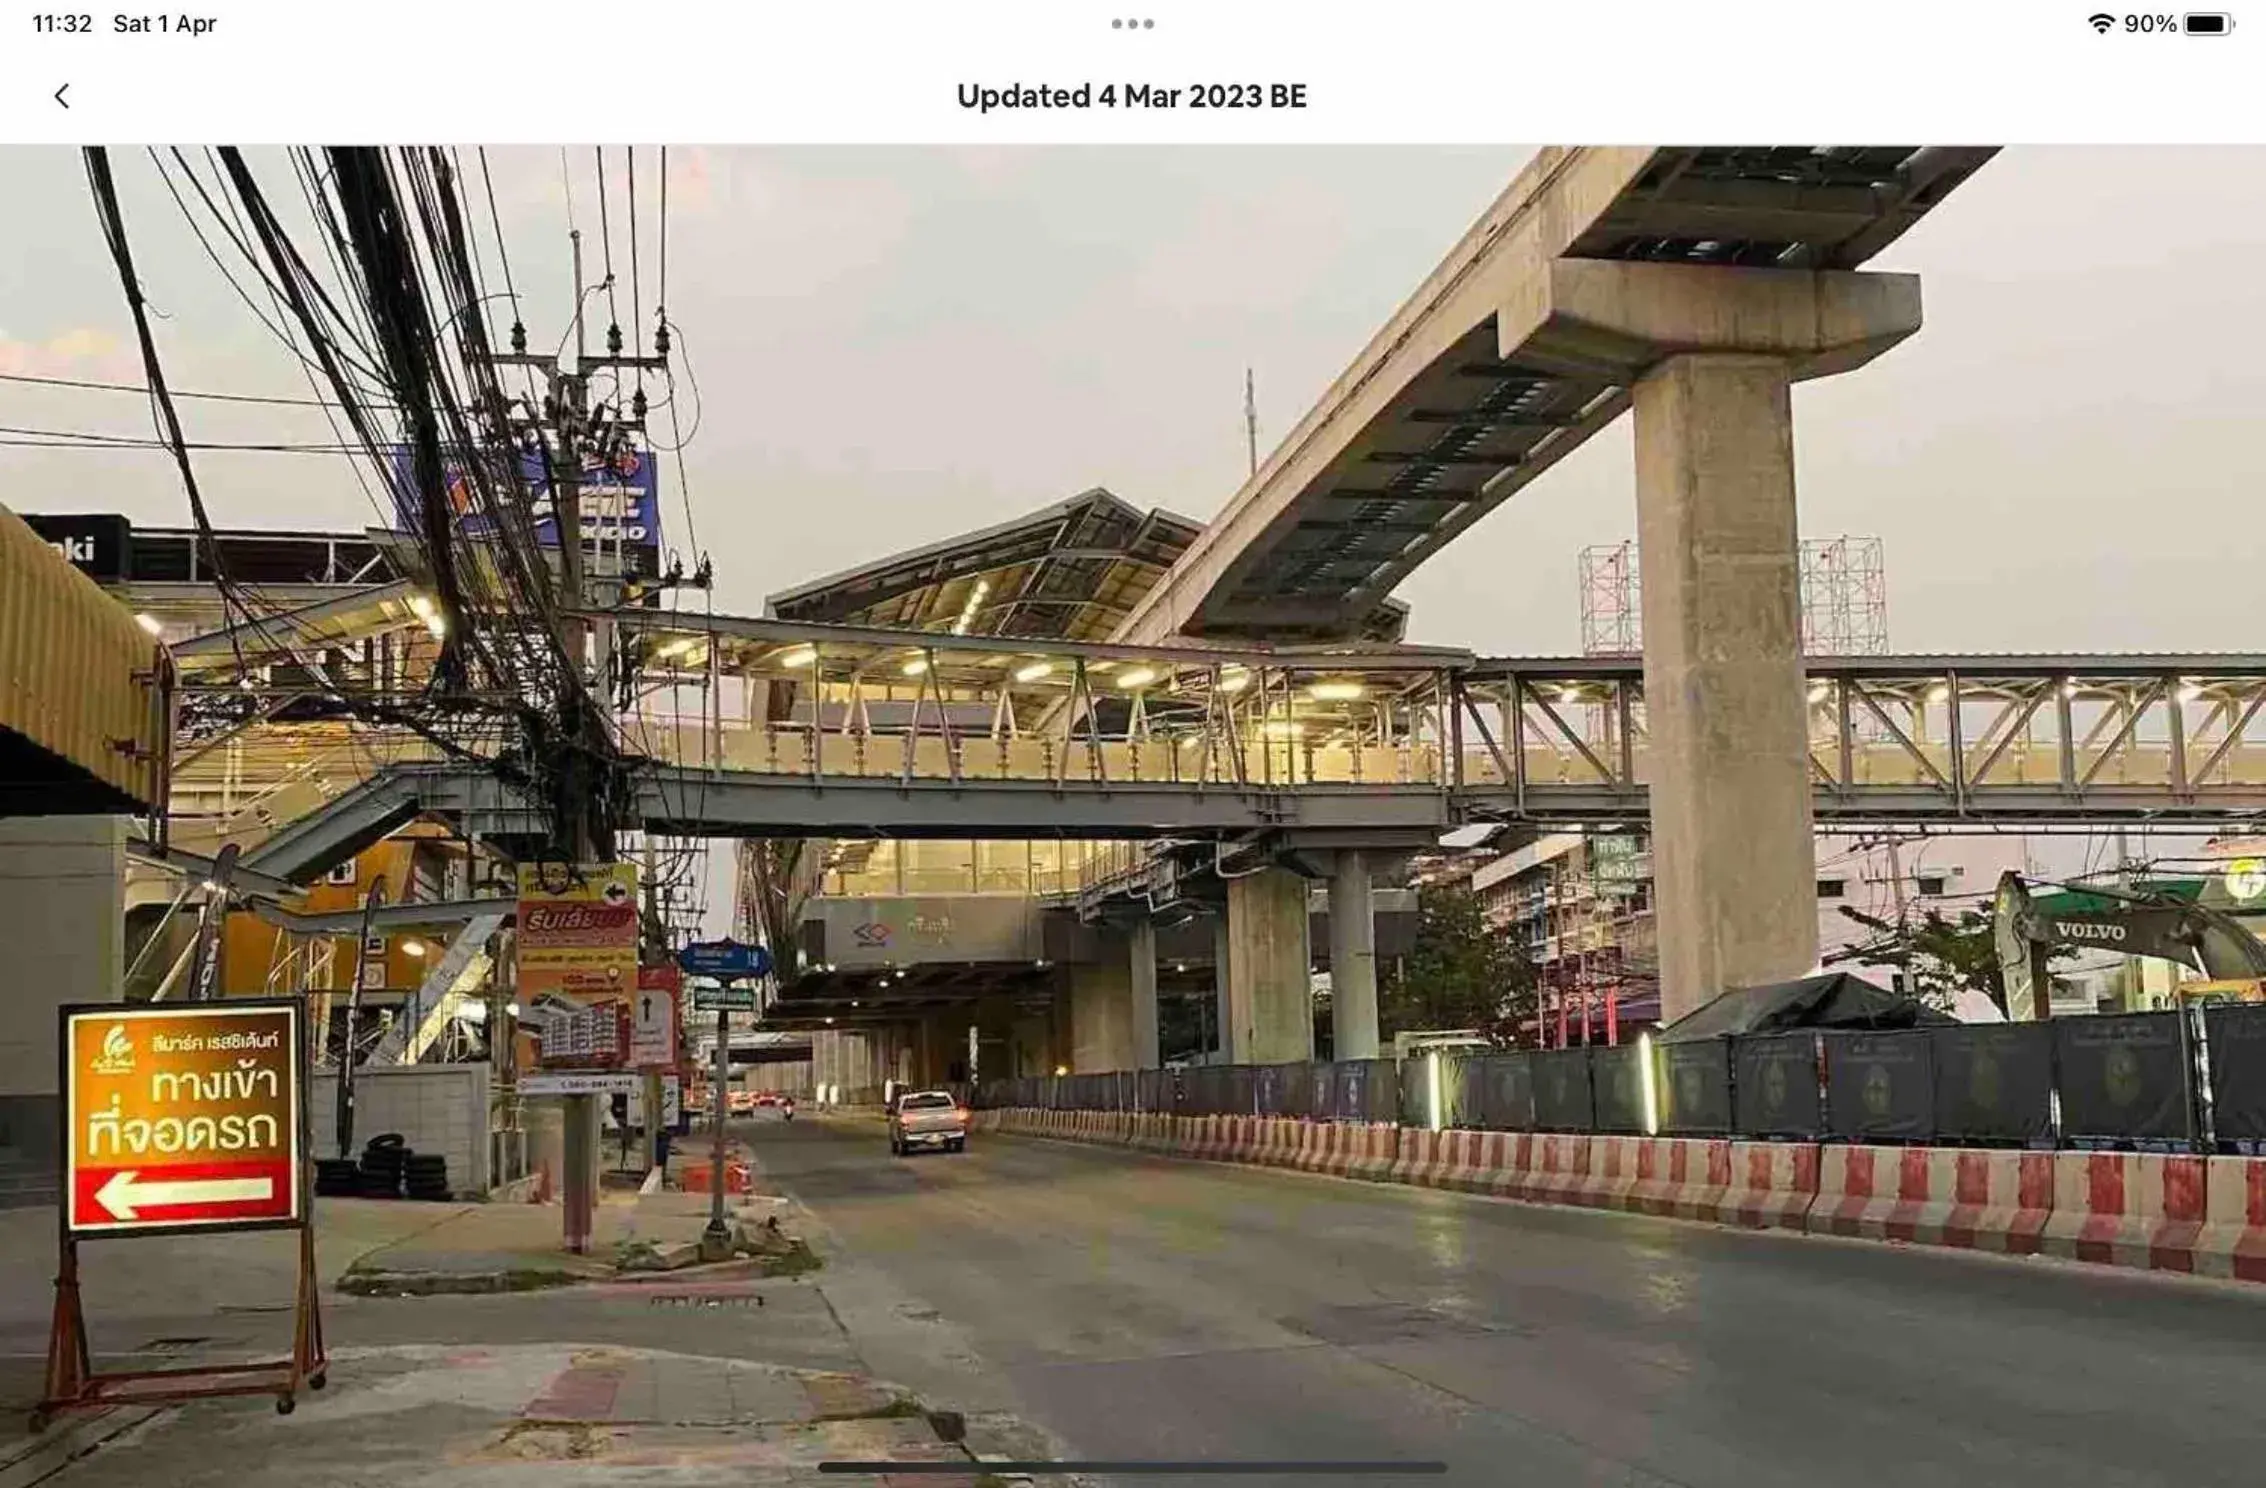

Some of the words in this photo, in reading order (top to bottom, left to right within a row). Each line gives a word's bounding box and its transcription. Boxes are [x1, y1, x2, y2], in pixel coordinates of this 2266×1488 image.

[2055, 921, 2127, 942] VOLVO
[152, 1057, 278, 1103] ทางเข้า
[88, 1093, 278, 1157] ที่จอดรถ
